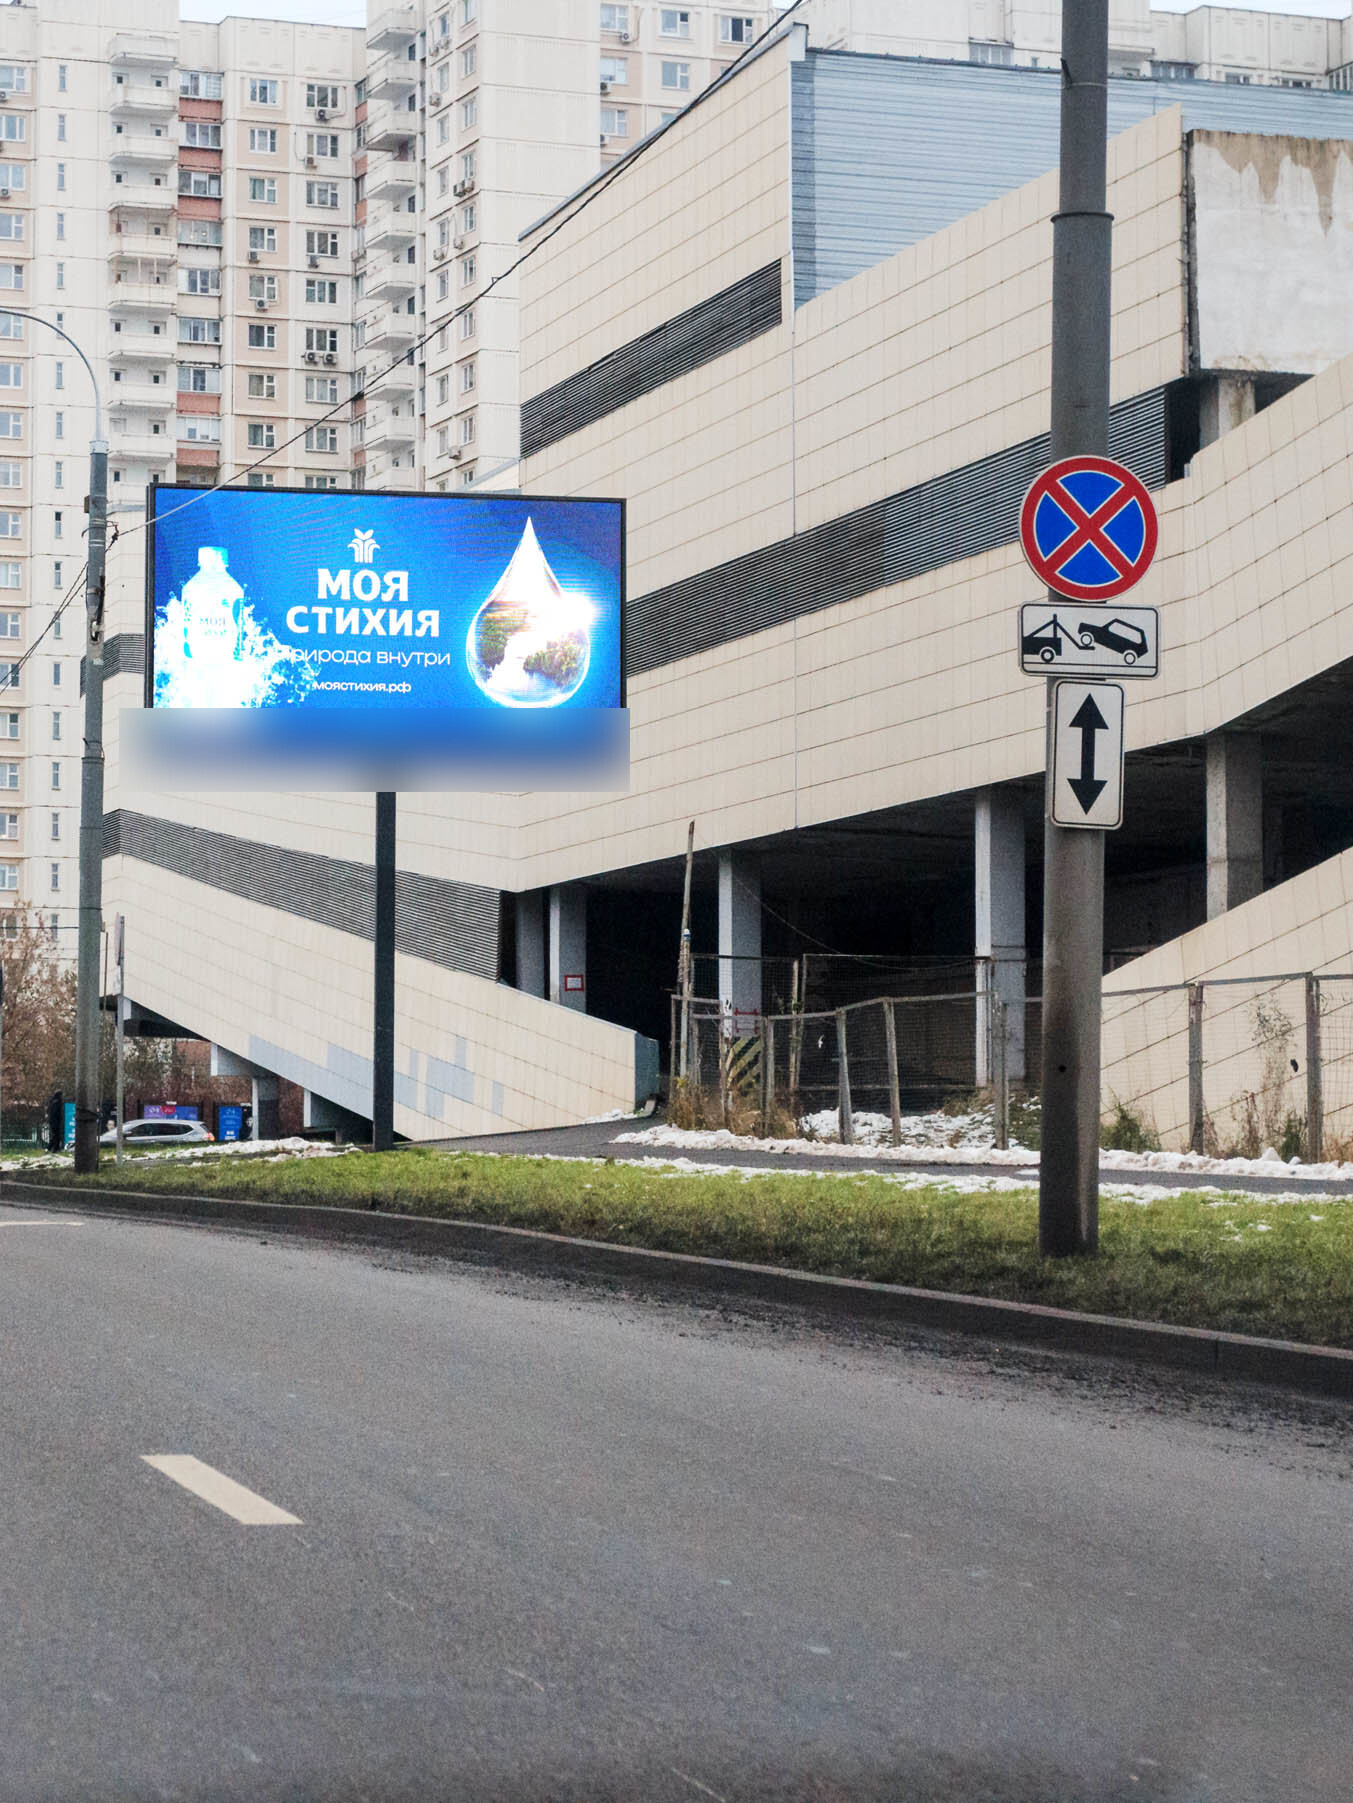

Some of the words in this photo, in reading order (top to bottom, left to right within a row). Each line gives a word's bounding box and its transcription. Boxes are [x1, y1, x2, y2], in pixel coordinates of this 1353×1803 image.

[317, 568, 409, 602] МОЯ
[285, 605, 440, 638] СТИХИЯ
[279, 648, 372, 666] рирода
[376, 651, 451, 668] внутри
[312, 680, 412, 694] моястихия.рф
